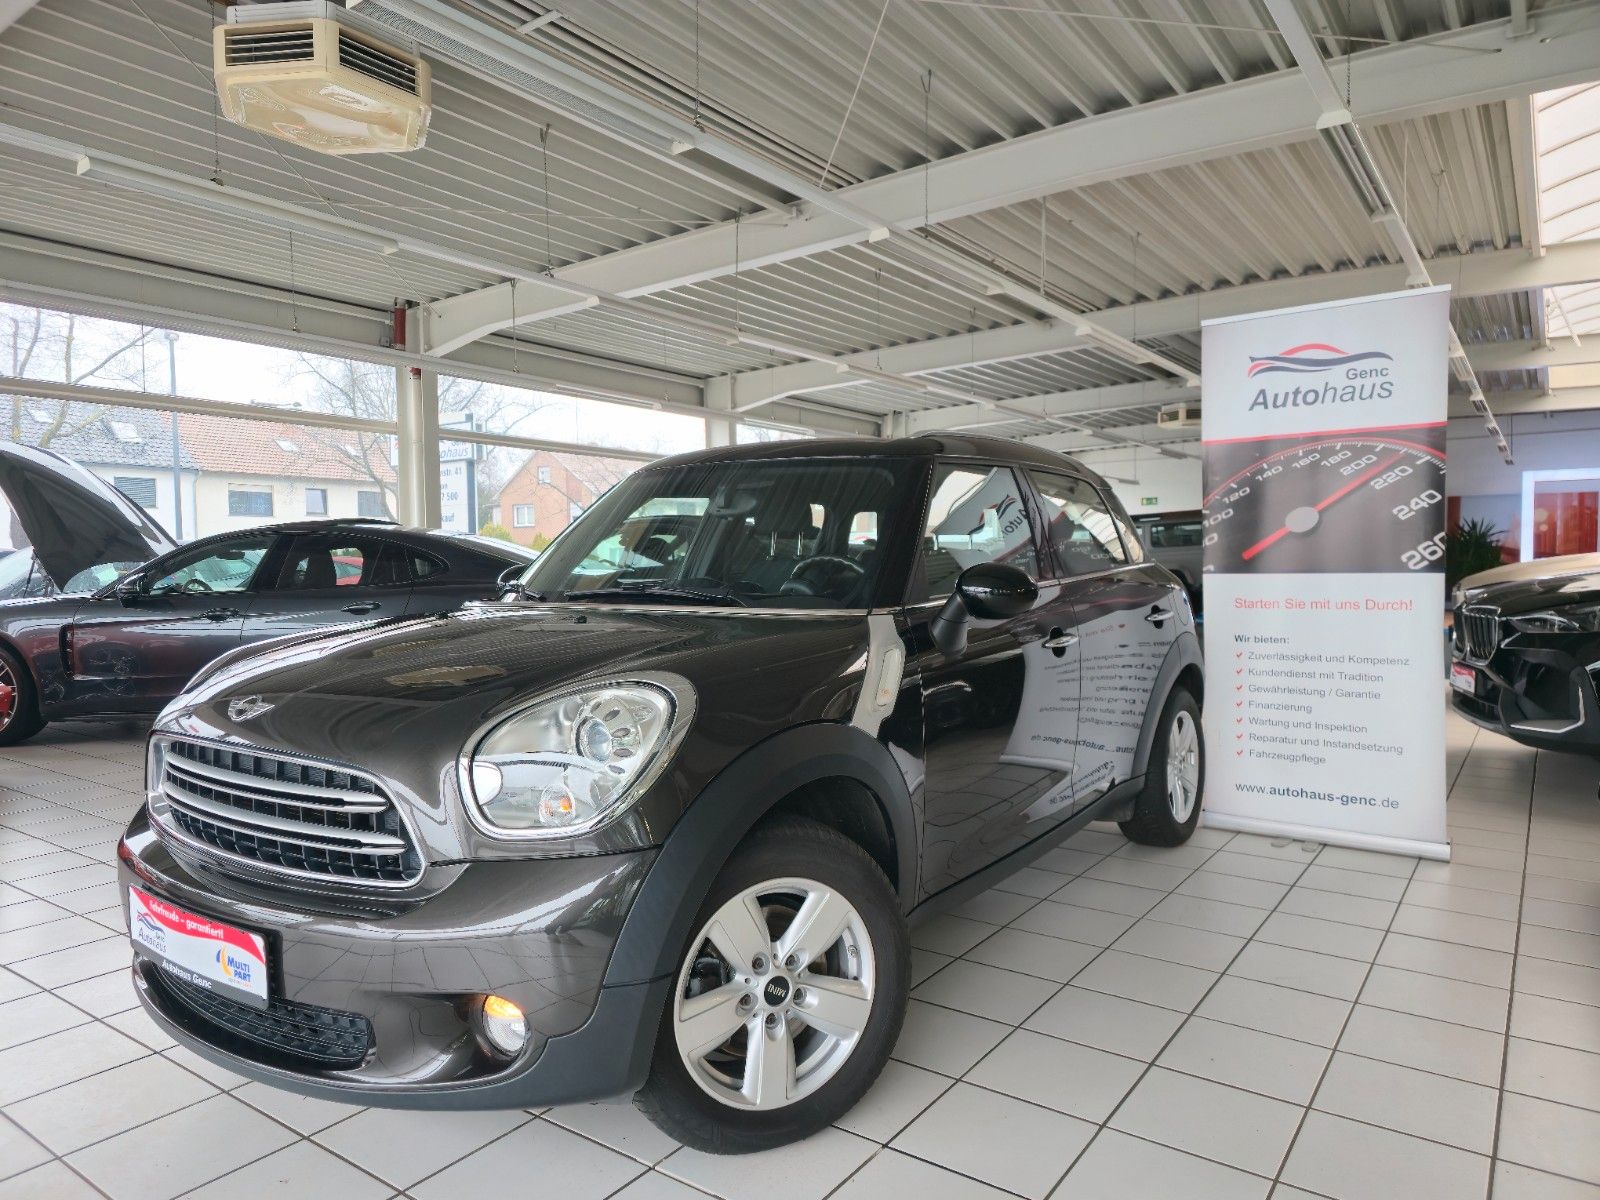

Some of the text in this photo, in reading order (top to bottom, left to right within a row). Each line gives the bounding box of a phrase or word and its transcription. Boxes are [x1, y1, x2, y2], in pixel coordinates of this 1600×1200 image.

[1345, 367, 1390, 380] Genc
[1248, 381, 1394, 411] Autohaus
[440, 446, 469, 459] ohaus
[1321, 450, 1352, 467] 180
[1292, 453, 1320, 469] 160
[1339, 454, 1378, 476] 200
[1255, 465, 1283, 481] 140
[1370, 465, 1414, 490] 220
[1222, 487, 1250, 504] 120
[1392, 489, 1442, 520] 240
[1202, 508, 1234, 528] 100
[1202, 533, 1218, 549] 0
[1234, 598, 1413, 611] Starten Sie mit uns Durch!
[1234, 634, 1290, 644] Wir bieten:
[1248, 651, 1411, 667] Zuverlässigkeit und Kompetenz
[1248, 667, 1384, 683] Kundendienst mit Tradition
[1248, 683, 1326, 698] Gewährleistung
[1335, 688, 1381, 700] Garantie
[1248, 700, 1313, 714] Finanzierung
[1248, 716, 1368, 734] Wartung und Inspektion
[1249, 733, 1404, 756] Reparatur und Instandsetzung
[1249, 749, 1327, 765] Fahrzeugpflege
[1235, 782, 1400, 810] www.autohaus-genc.de
[161, 959, 192, 982] Autohaus
[192, 973, 213, 989] Genc
[233, 969, 252, 983] PART
